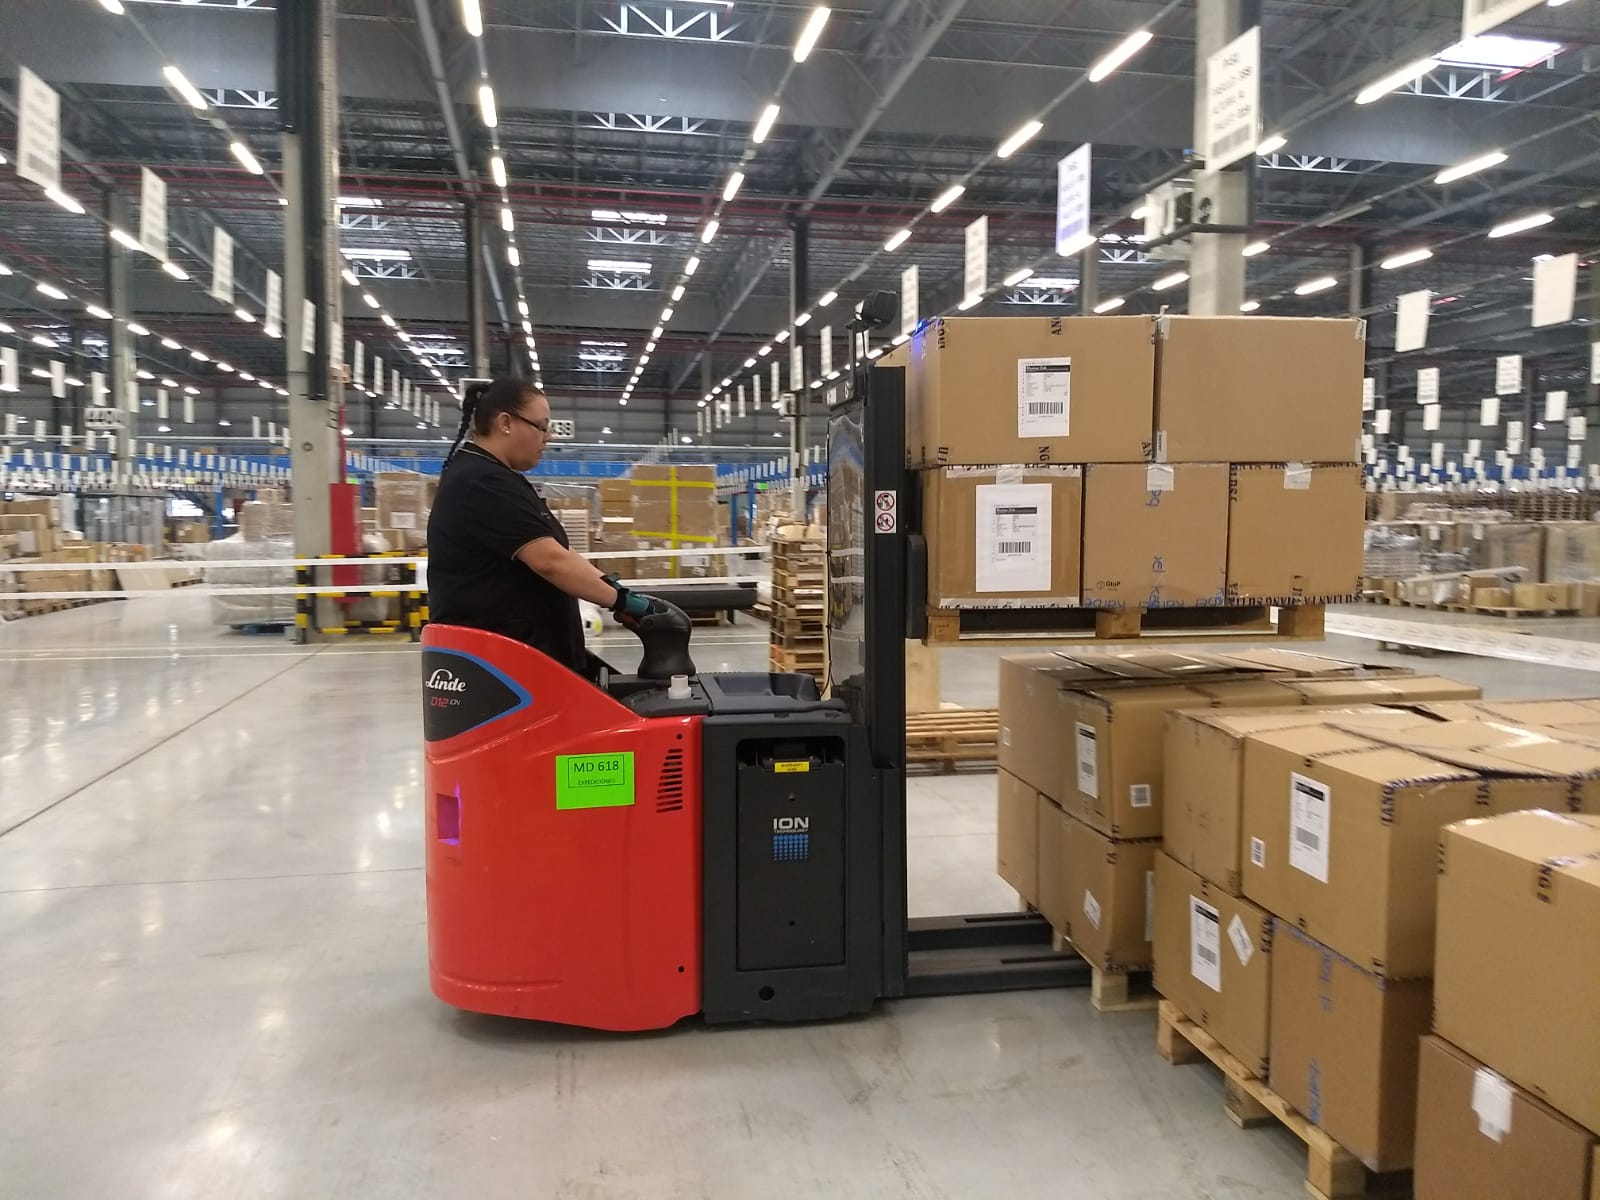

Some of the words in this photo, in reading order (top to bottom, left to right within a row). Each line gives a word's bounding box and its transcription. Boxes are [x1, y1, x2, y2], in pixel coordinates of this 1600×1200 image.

[425, 668, 467, 692] Linde
[573, 762, 594, 773] MD
[598, 760, 619, 772] 618
[773, 816, 809, 830] ION
